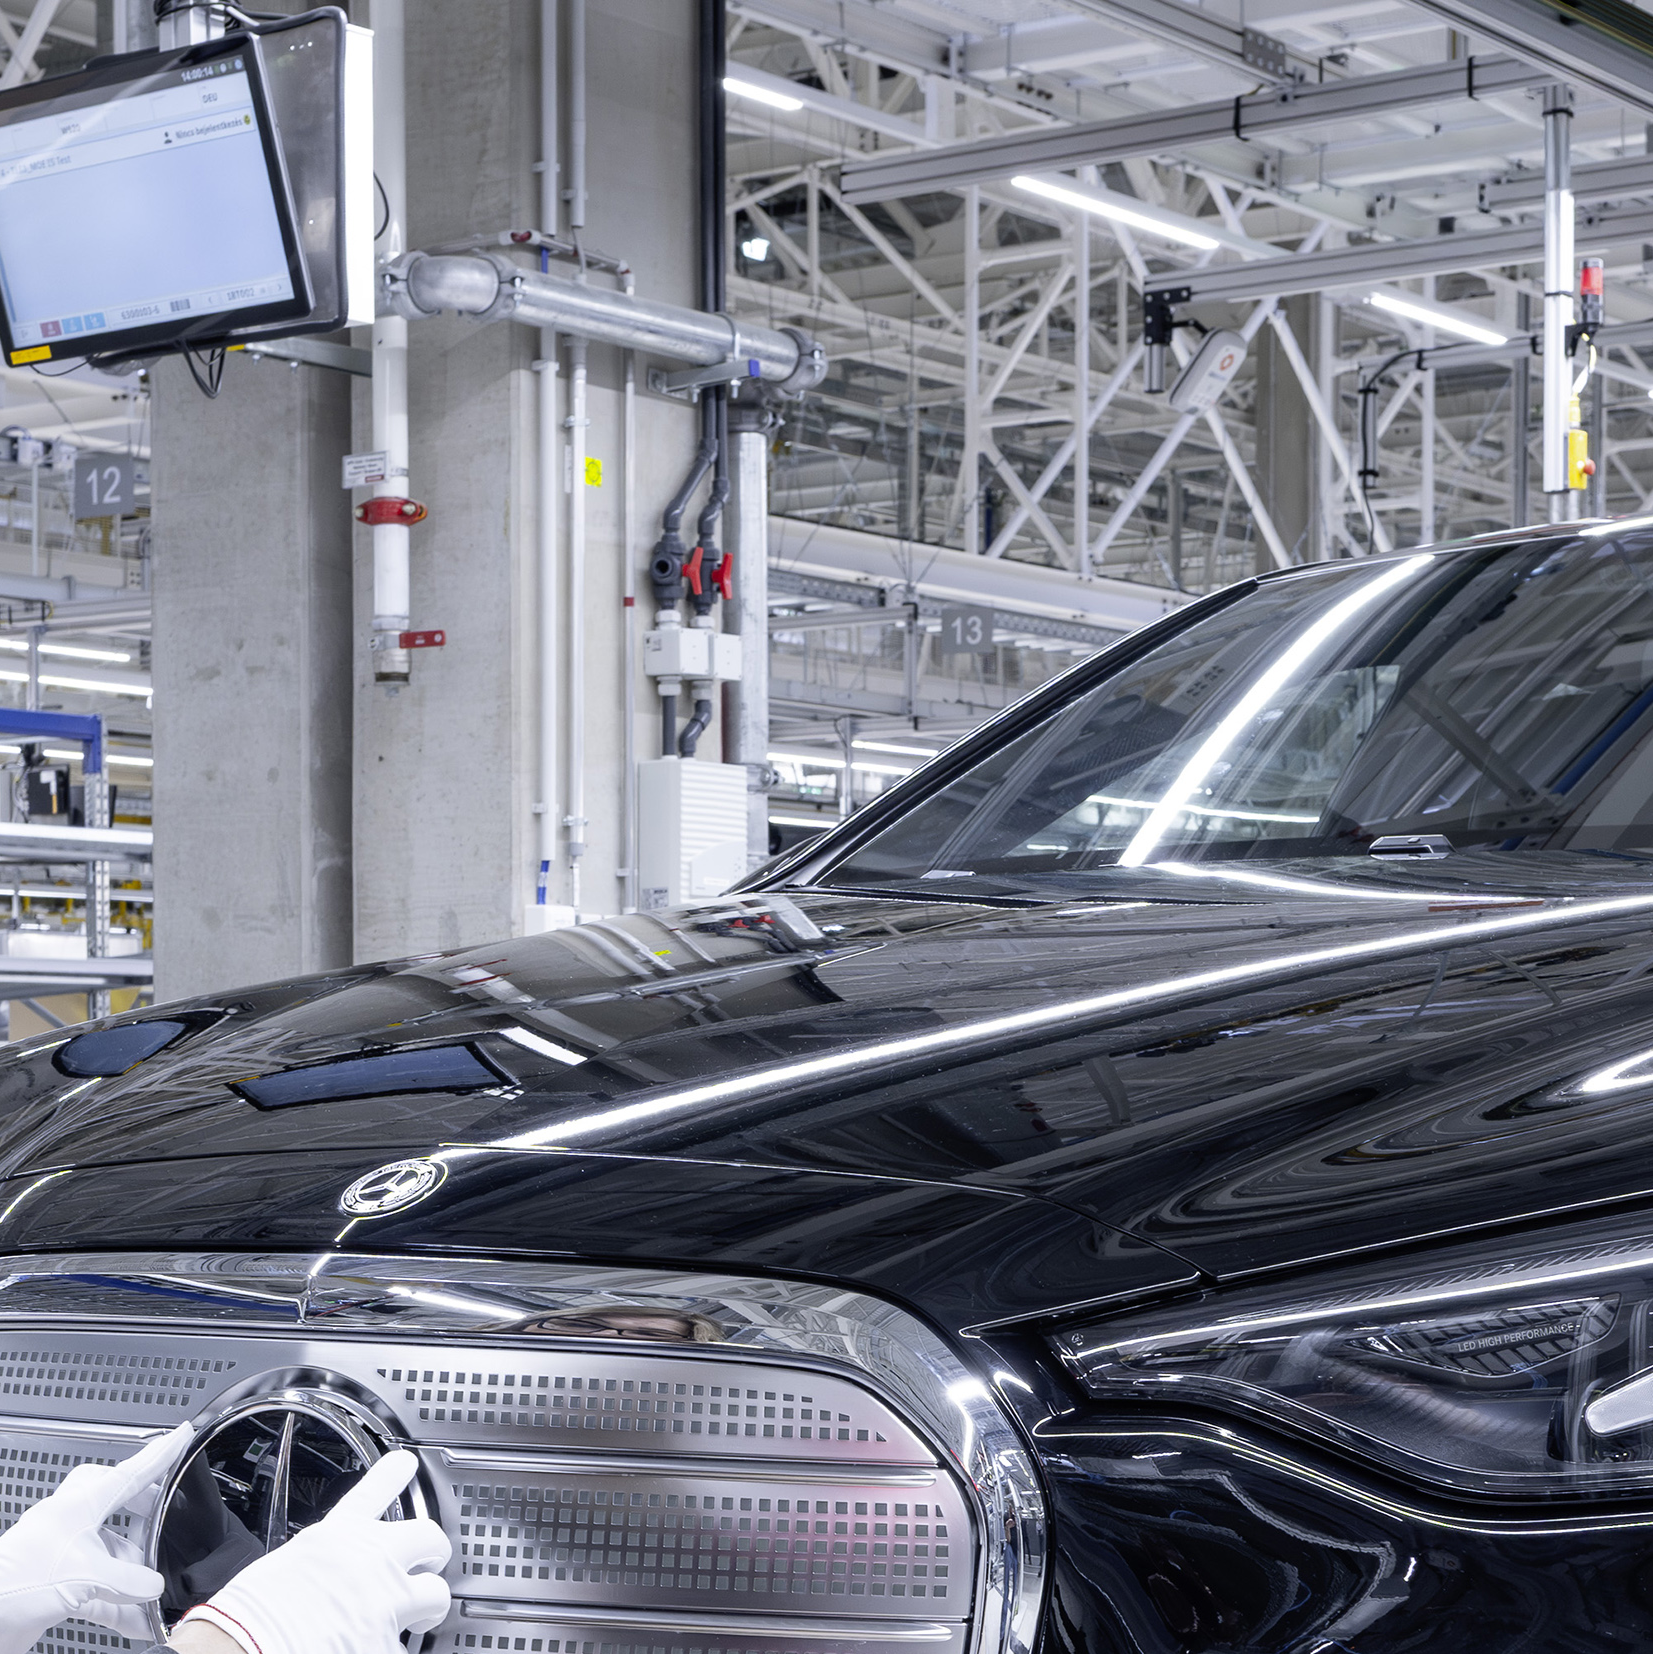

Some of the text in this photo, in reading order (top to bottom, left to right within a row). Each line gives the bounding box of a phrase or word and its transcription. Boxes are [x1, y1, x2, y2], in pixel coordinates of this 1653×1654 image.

[86, 466, 121, 506] 12
[951, 615, 982, 645] 13
[1457, 1322, 1574, 1352] LED HIGH PERFORMANCE
